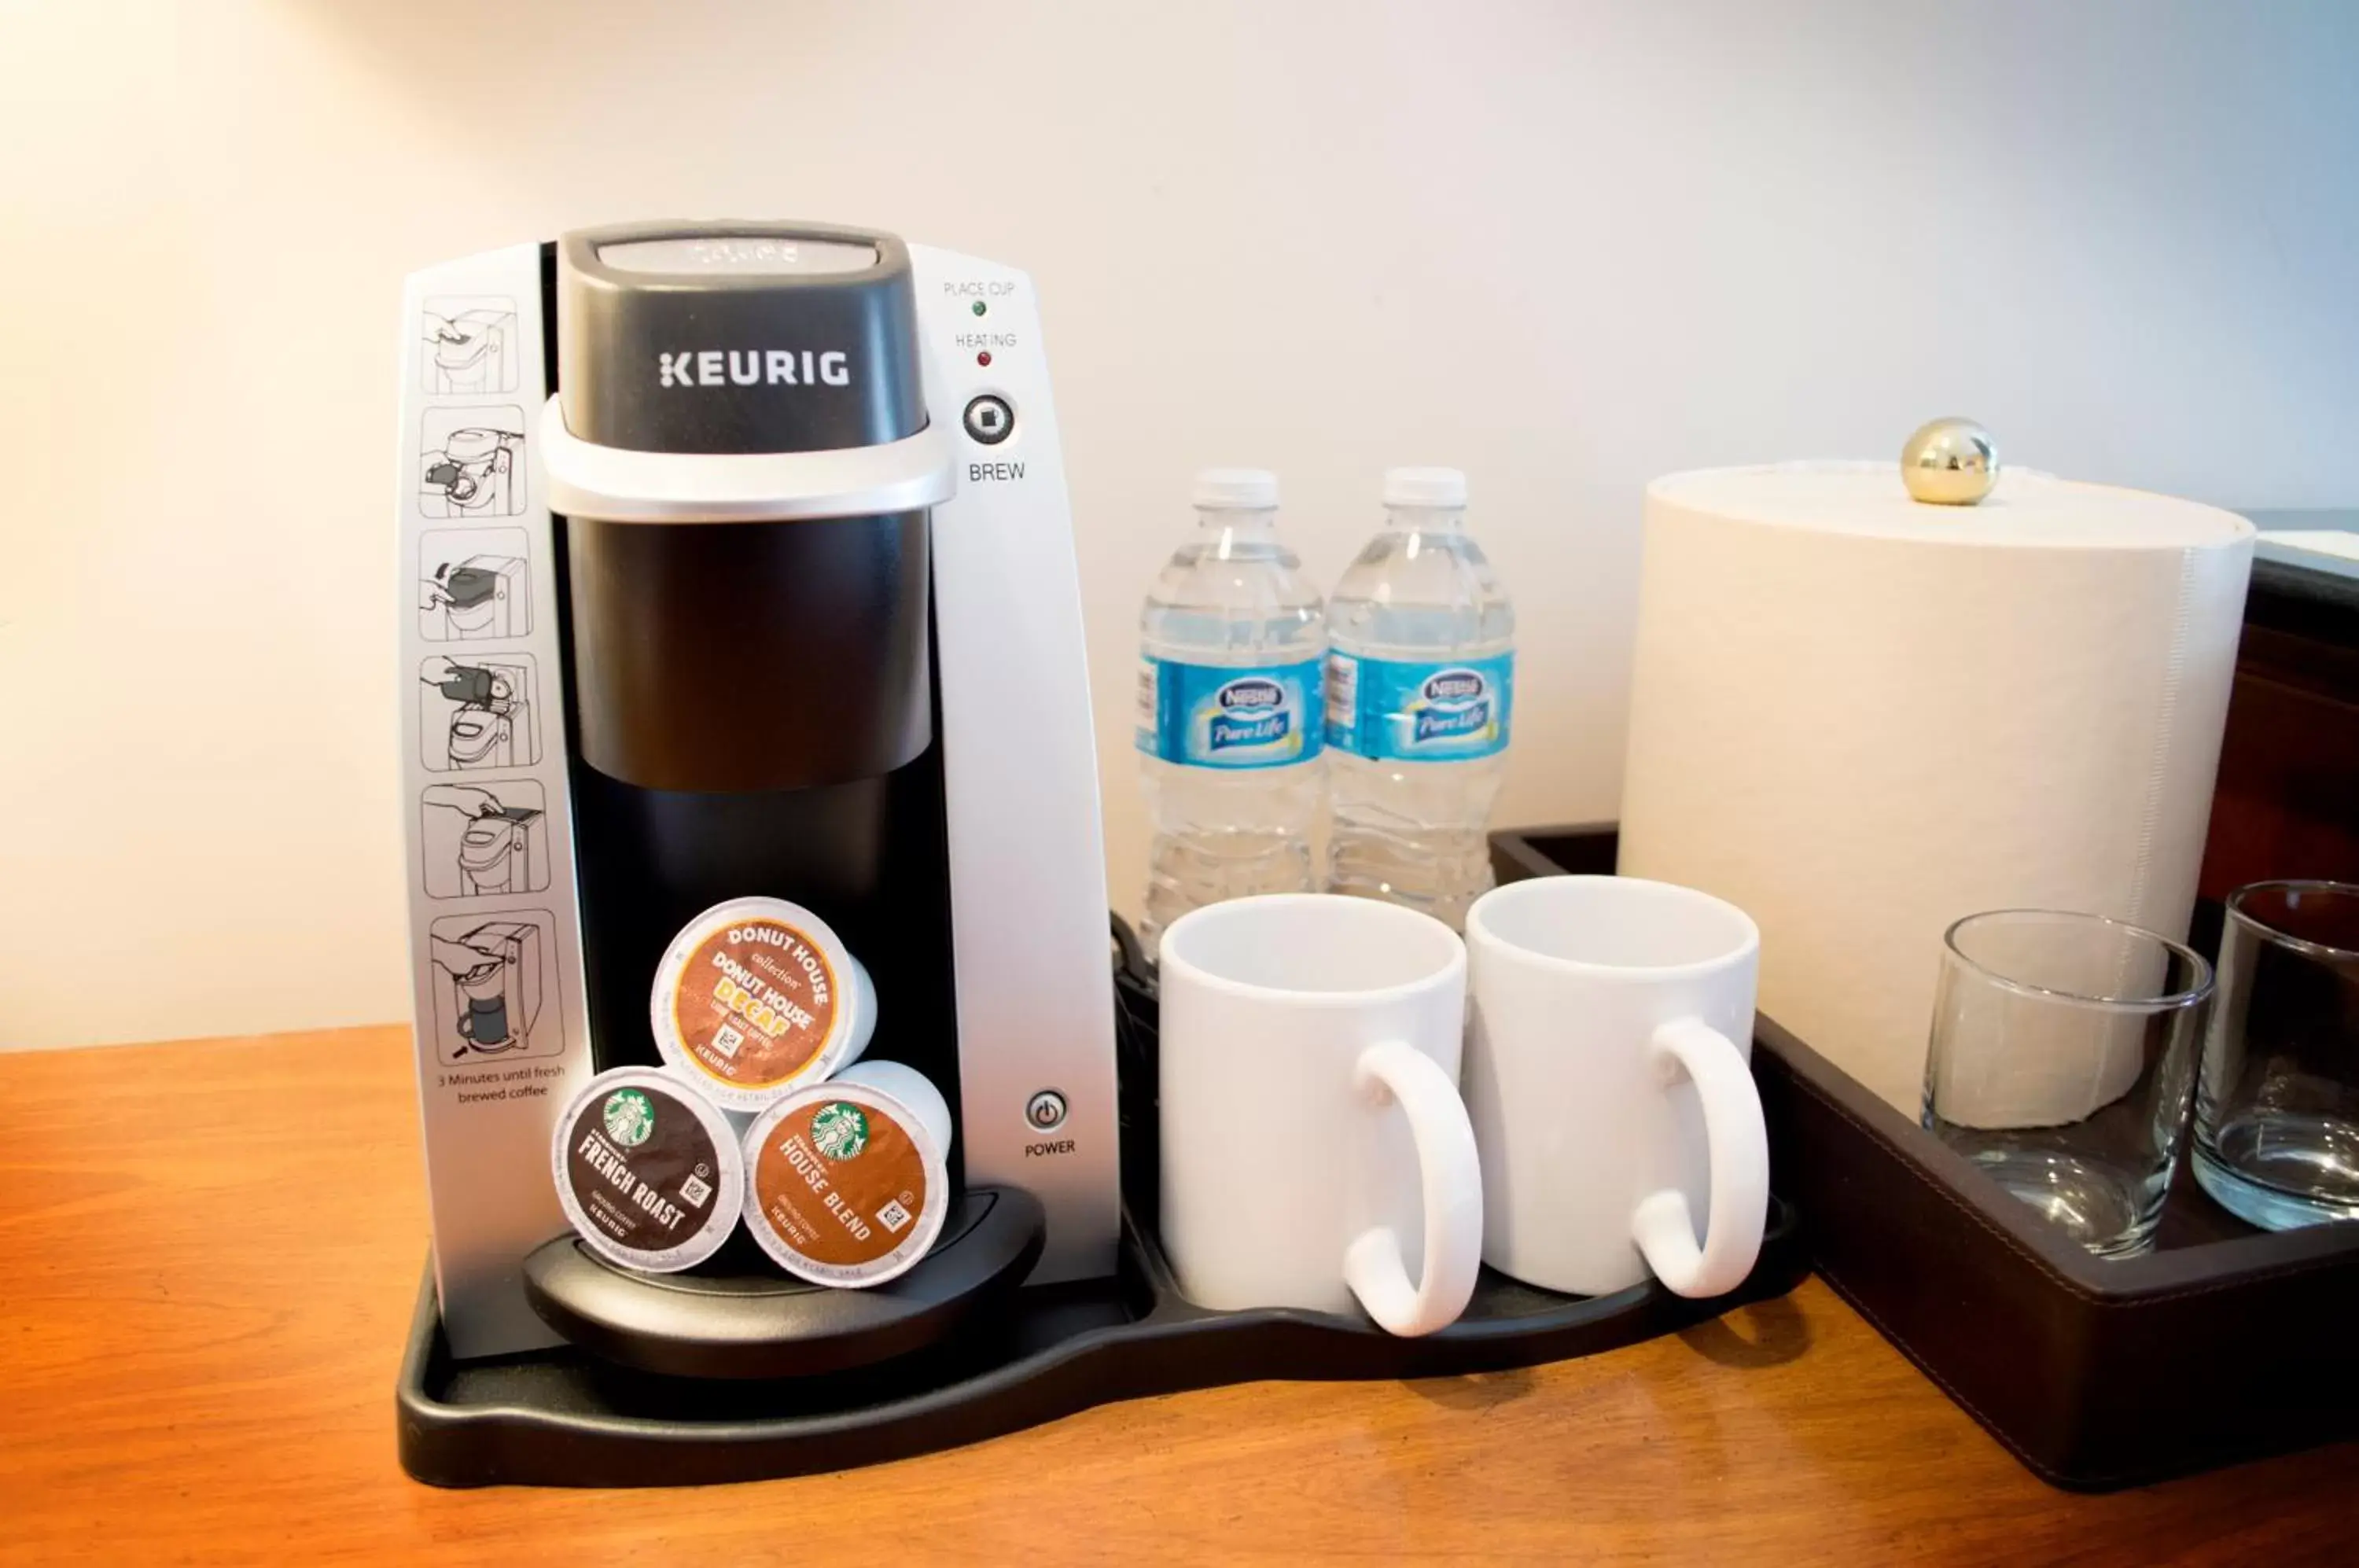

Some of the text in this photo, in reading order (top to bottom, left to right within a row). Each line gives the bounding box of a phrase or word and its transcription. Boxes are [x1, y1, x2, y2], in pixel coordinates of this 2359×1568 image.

[944, 282, 1016, 296] PLACE CUP
[955, 333, 1018, 348] HEATING
[659, 350, 850, 388] KEURIG
[969, 462, 1025, 482] BREW
[728, 926, 829, 1007] DONUT HOUSE
[712, 951, 815, 1032] DONUT HOUSE
[712, 975, 791, 1038] DECAF
[439, 1065, 565, 1087] 3 Minutes until fresh
[695, 1043, 738, 1077] KEURIG
[458, 1085, 548, 1103] brewed coffee
[1025, 1139, 1076, 1158] POWER
[578, 1134, 637, 1194] FRENCH
[631, 1182, 686, 1231] ROAST
[779, 1138, 829, 1194] HOUSE
[823, 1191, 872, 1242] BLEND
[589, 1203, 627, 1238] KEURIG
[771, 1205, 807, 1247] KEURIG
